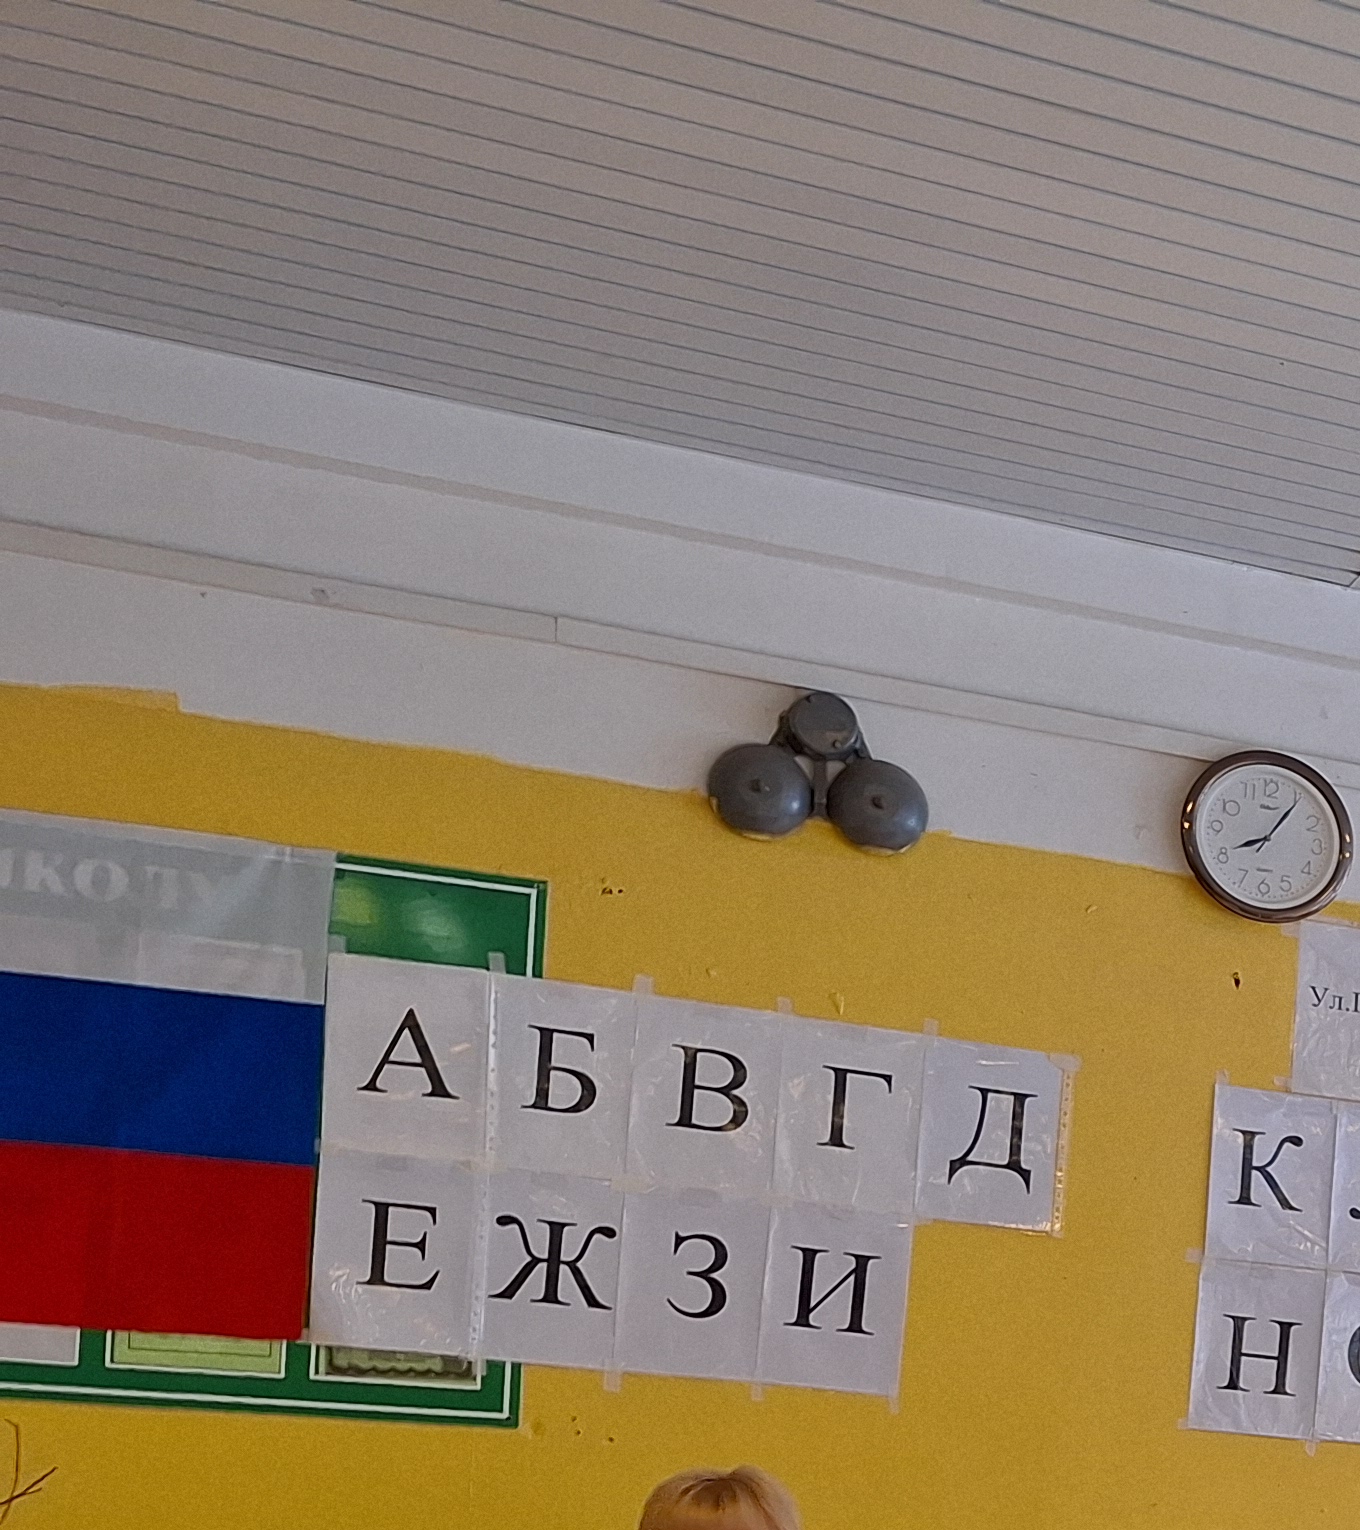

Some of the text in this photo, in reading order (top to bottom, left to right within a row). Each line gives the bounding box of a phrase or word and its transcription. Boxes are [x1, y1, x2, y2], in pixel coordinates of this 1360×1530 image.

[357, 1008, 1034, 1194] А Б В Г Д
[1228, 1128, 1304, 1213] К
[360, 1199, 882, 1337] Е Ж З И
[1216, 1313, 1303, 1397] Н
